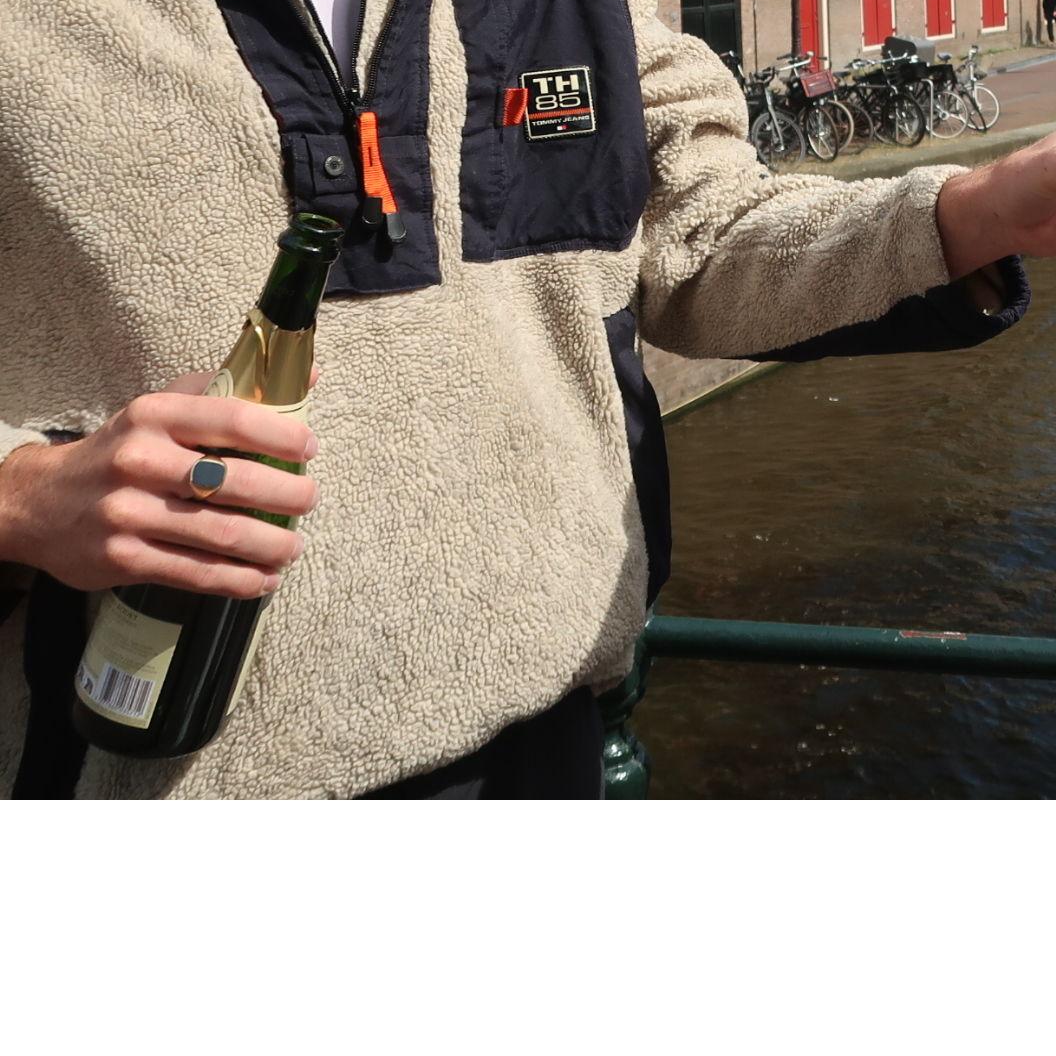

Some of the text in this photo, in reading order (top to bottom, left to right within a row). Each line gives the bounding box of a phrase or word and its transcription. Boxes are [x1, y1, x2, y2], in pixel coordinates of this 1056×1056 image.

[532, 74, 580, 94] TH
[535, 91, 581, 111] 85
[532, 118, 562, 126] TOMMY
